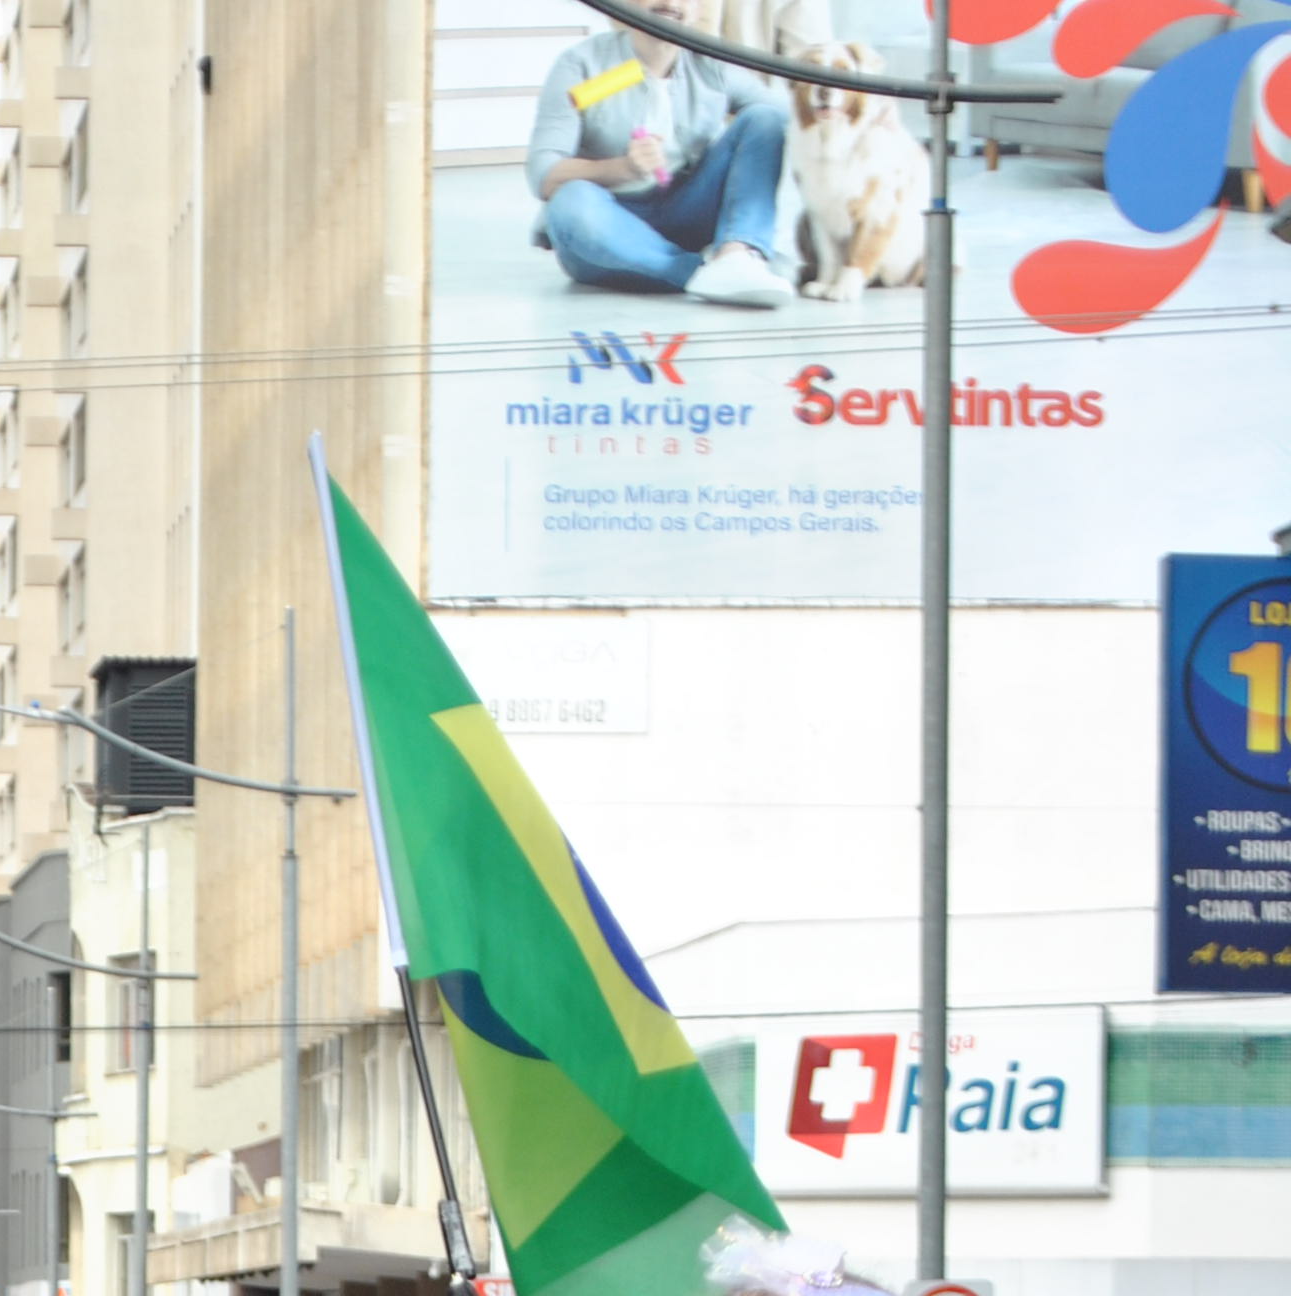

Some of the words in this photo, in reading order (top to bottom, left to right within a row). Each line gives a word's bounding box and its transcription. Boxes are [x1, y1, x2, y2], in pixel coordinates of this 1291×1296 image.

[506, 397, 612, 426] miara
[620, 397, 754, 434] krüger
[547, 435, 712, 455] tintas
[543, 483, 618, 508] Grupo
[623, 484, 690, 504] Miara
[788, 483, 817, 504] há
[543, 511, 653, 531] colorindo
[660, 515, 688, 531] os
[693, 511, 791, 536] Campos
[798, 511, 881, 532] Gerais.
